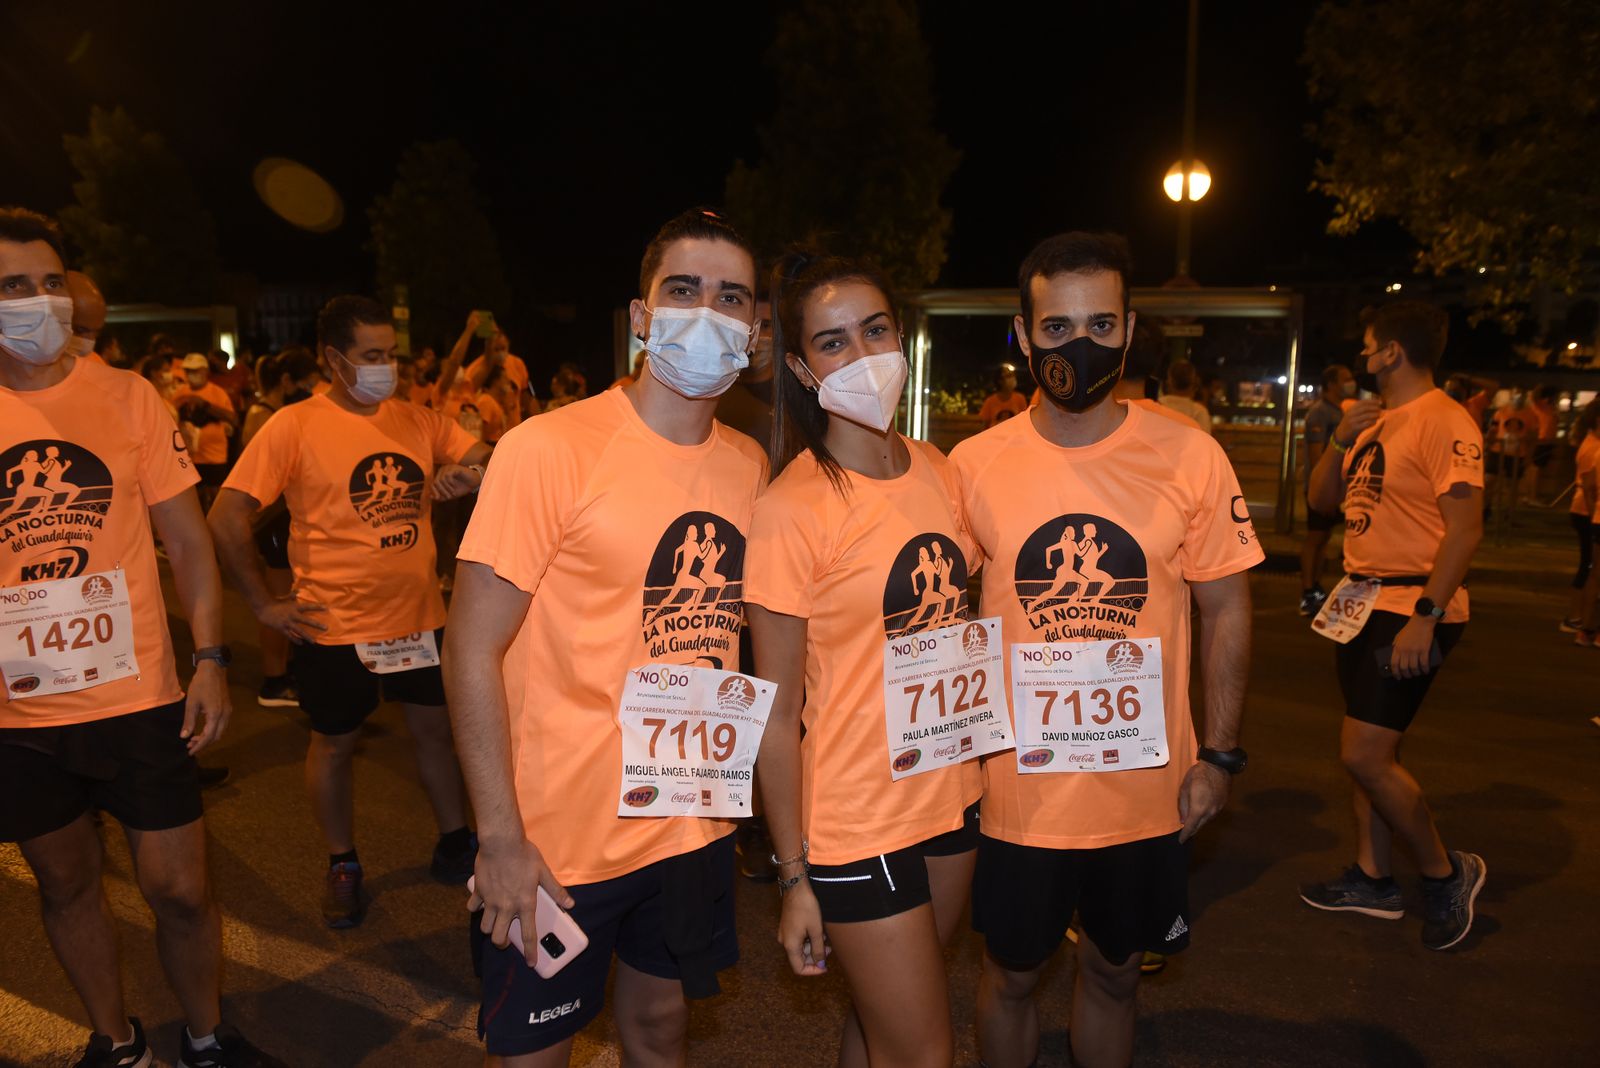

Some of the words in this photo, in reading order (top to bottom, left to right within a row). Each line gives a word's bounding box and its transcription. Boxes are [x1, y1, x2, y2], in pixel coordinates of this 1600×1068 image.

[17, 513, 103, 530] NOCTURNA
[11, 537, 26, 553] del
[25, 529, 94, 545] Guadalquivir
[1028, 613, 1051, 630] LA
[16, 612, 114, 657] 1420
[643, 624, 660, 644] LA
[1044, 626, 1062, 643] del
[650, 639, 668, 658] del
[922, 668, 949, 678] NOCTURNA
[1097, 676, 1135, 685] GUADALQUIVIR
[903, 668, 989, 724] 7122
[641, 706, 666, 714] CARRERA
[665, 708, 694, 717] NOCTURNA
[701, 710, 740, 721] GUADALQUIVIR
[1034, 685, 1141, 726] 7136
[903, 728, 930, 743] PAULA
[931, 717, 969, 735] MARTÍNEZ
[969, 710, 994, 725] RIVERA
[1042, 732, 1070, 742] DAVID
[1071, 730, 1106, 742] MUÑOZ
[1107, 727, 1139, 740] GASCO
[642, 717, 737, 763] 7119
[1142, 745, 1157, 754] ABC
[625, 764, 660, 776] MIGUEL
[661, 765, 690, 778] ÁNGEL
[691, 768, 720, 780] FAJARDO
[720, 770, 751, 781] RAMOS
[528, 998, 581, 1024] LEGEA
